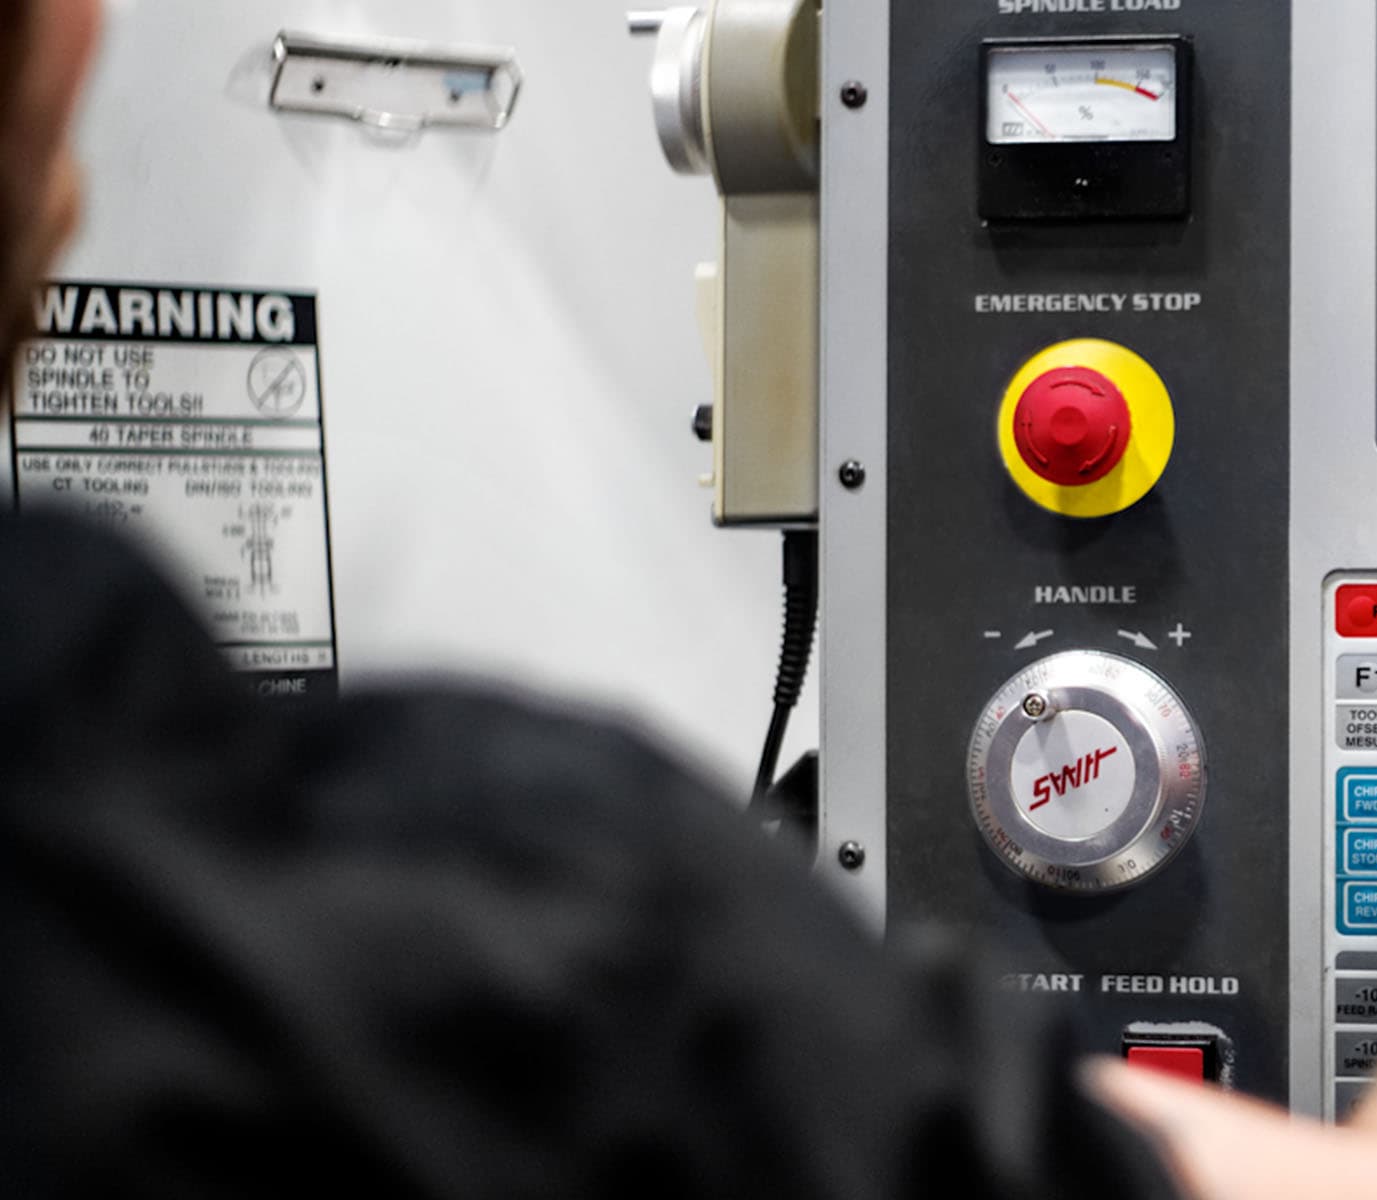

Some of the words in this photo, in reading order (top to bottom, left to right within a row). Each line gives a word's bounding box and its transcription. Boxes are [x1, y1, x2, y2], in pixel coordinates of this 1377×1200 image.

[999, 0, 1105, 13] SPINDLE
[1111, 0, 1180, 10] LOAD
[975, 294, 1126, 312] EMERGENCY
[1132, 293, 1201, 311] STOP
[37, 286, 295, 342] WARNING
[26, 348, 57, 364] DO
[64, 349, 105, 365] NOT
[114, 349, 154, 365] USE
[28, 370, 115, 389] SPINDLE
[124, 372, 151, 390] TO
[30, 393, 118, 412] TIGHTEN
[1035, 586, 1136, 603] HANDLE
[1001, 974, 1084, 992] TART
[1102, 974, 1163, 992] FEED
[1170, 976, 1239, 994] HOLD
[1337, 1005, 1365, 1016] FEED
